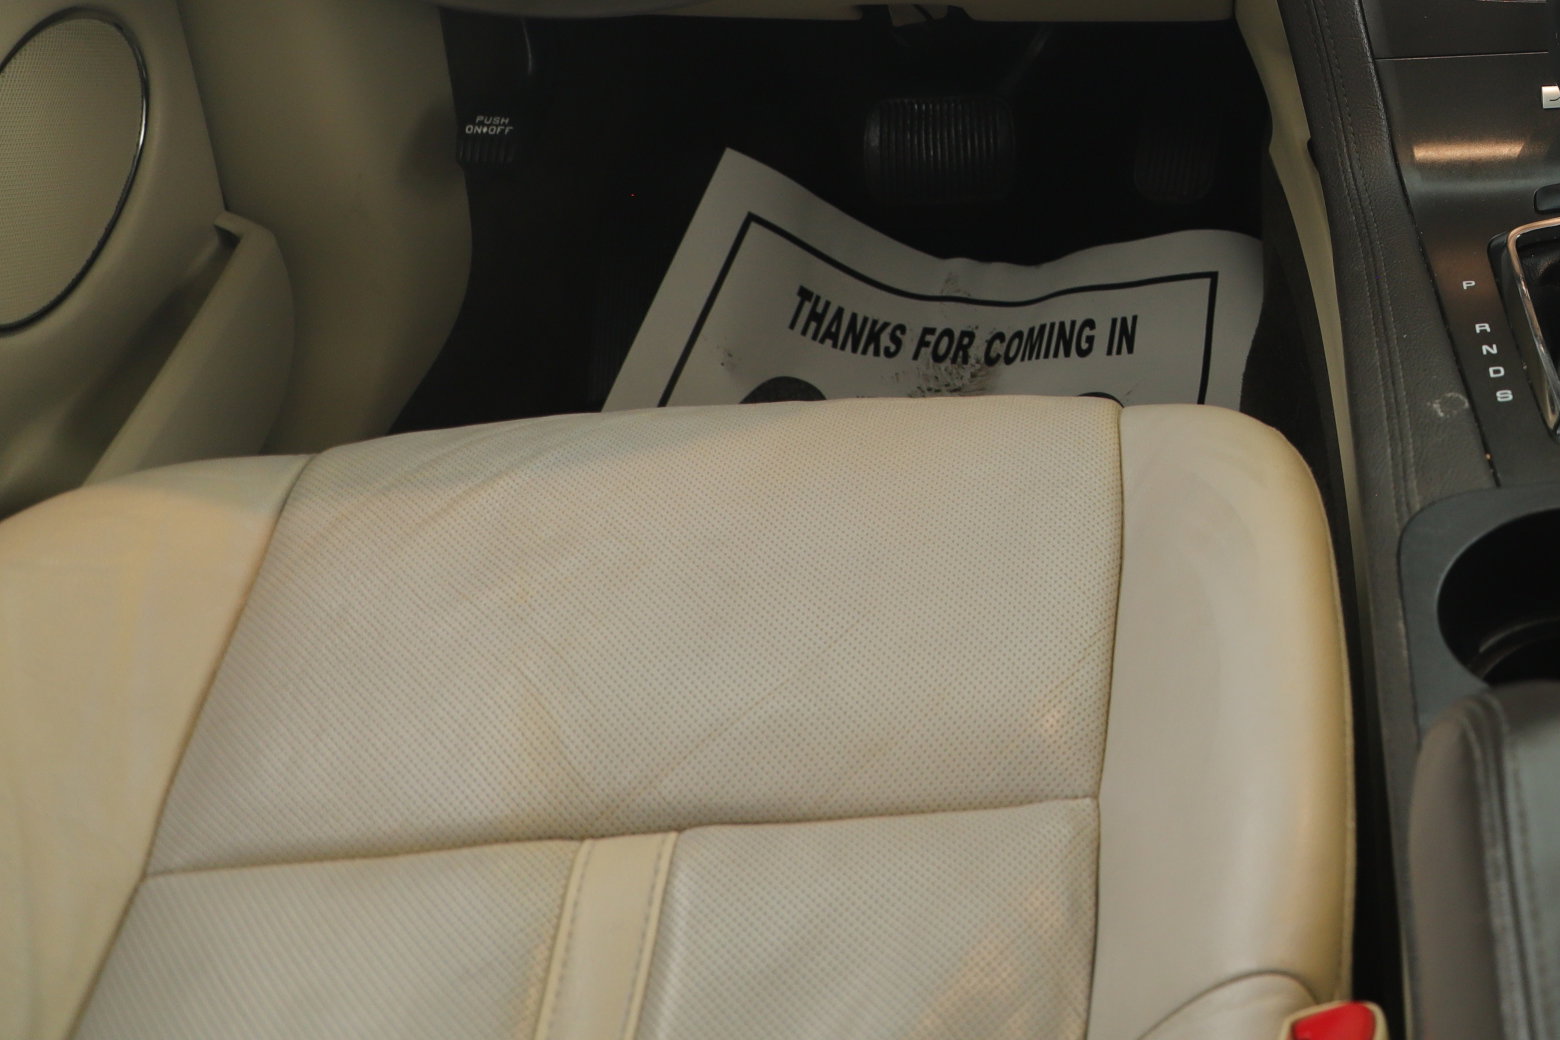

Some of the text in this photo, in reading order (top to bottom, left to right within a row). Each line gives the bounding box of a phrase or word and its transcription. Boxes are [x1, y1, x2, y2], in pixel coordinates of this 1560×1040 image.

[475, 115, 510, 125] PUSH
[1462, 280, 1476, 290] P
[787, 284, 1139, 368] THANKS FOR COMING IN
[1475, 322, 1491, 334] R
[1481, 344, 1498, 355] N
[1489, 366, 1506, 378] D
[1495, 389, 1513, 402] S
